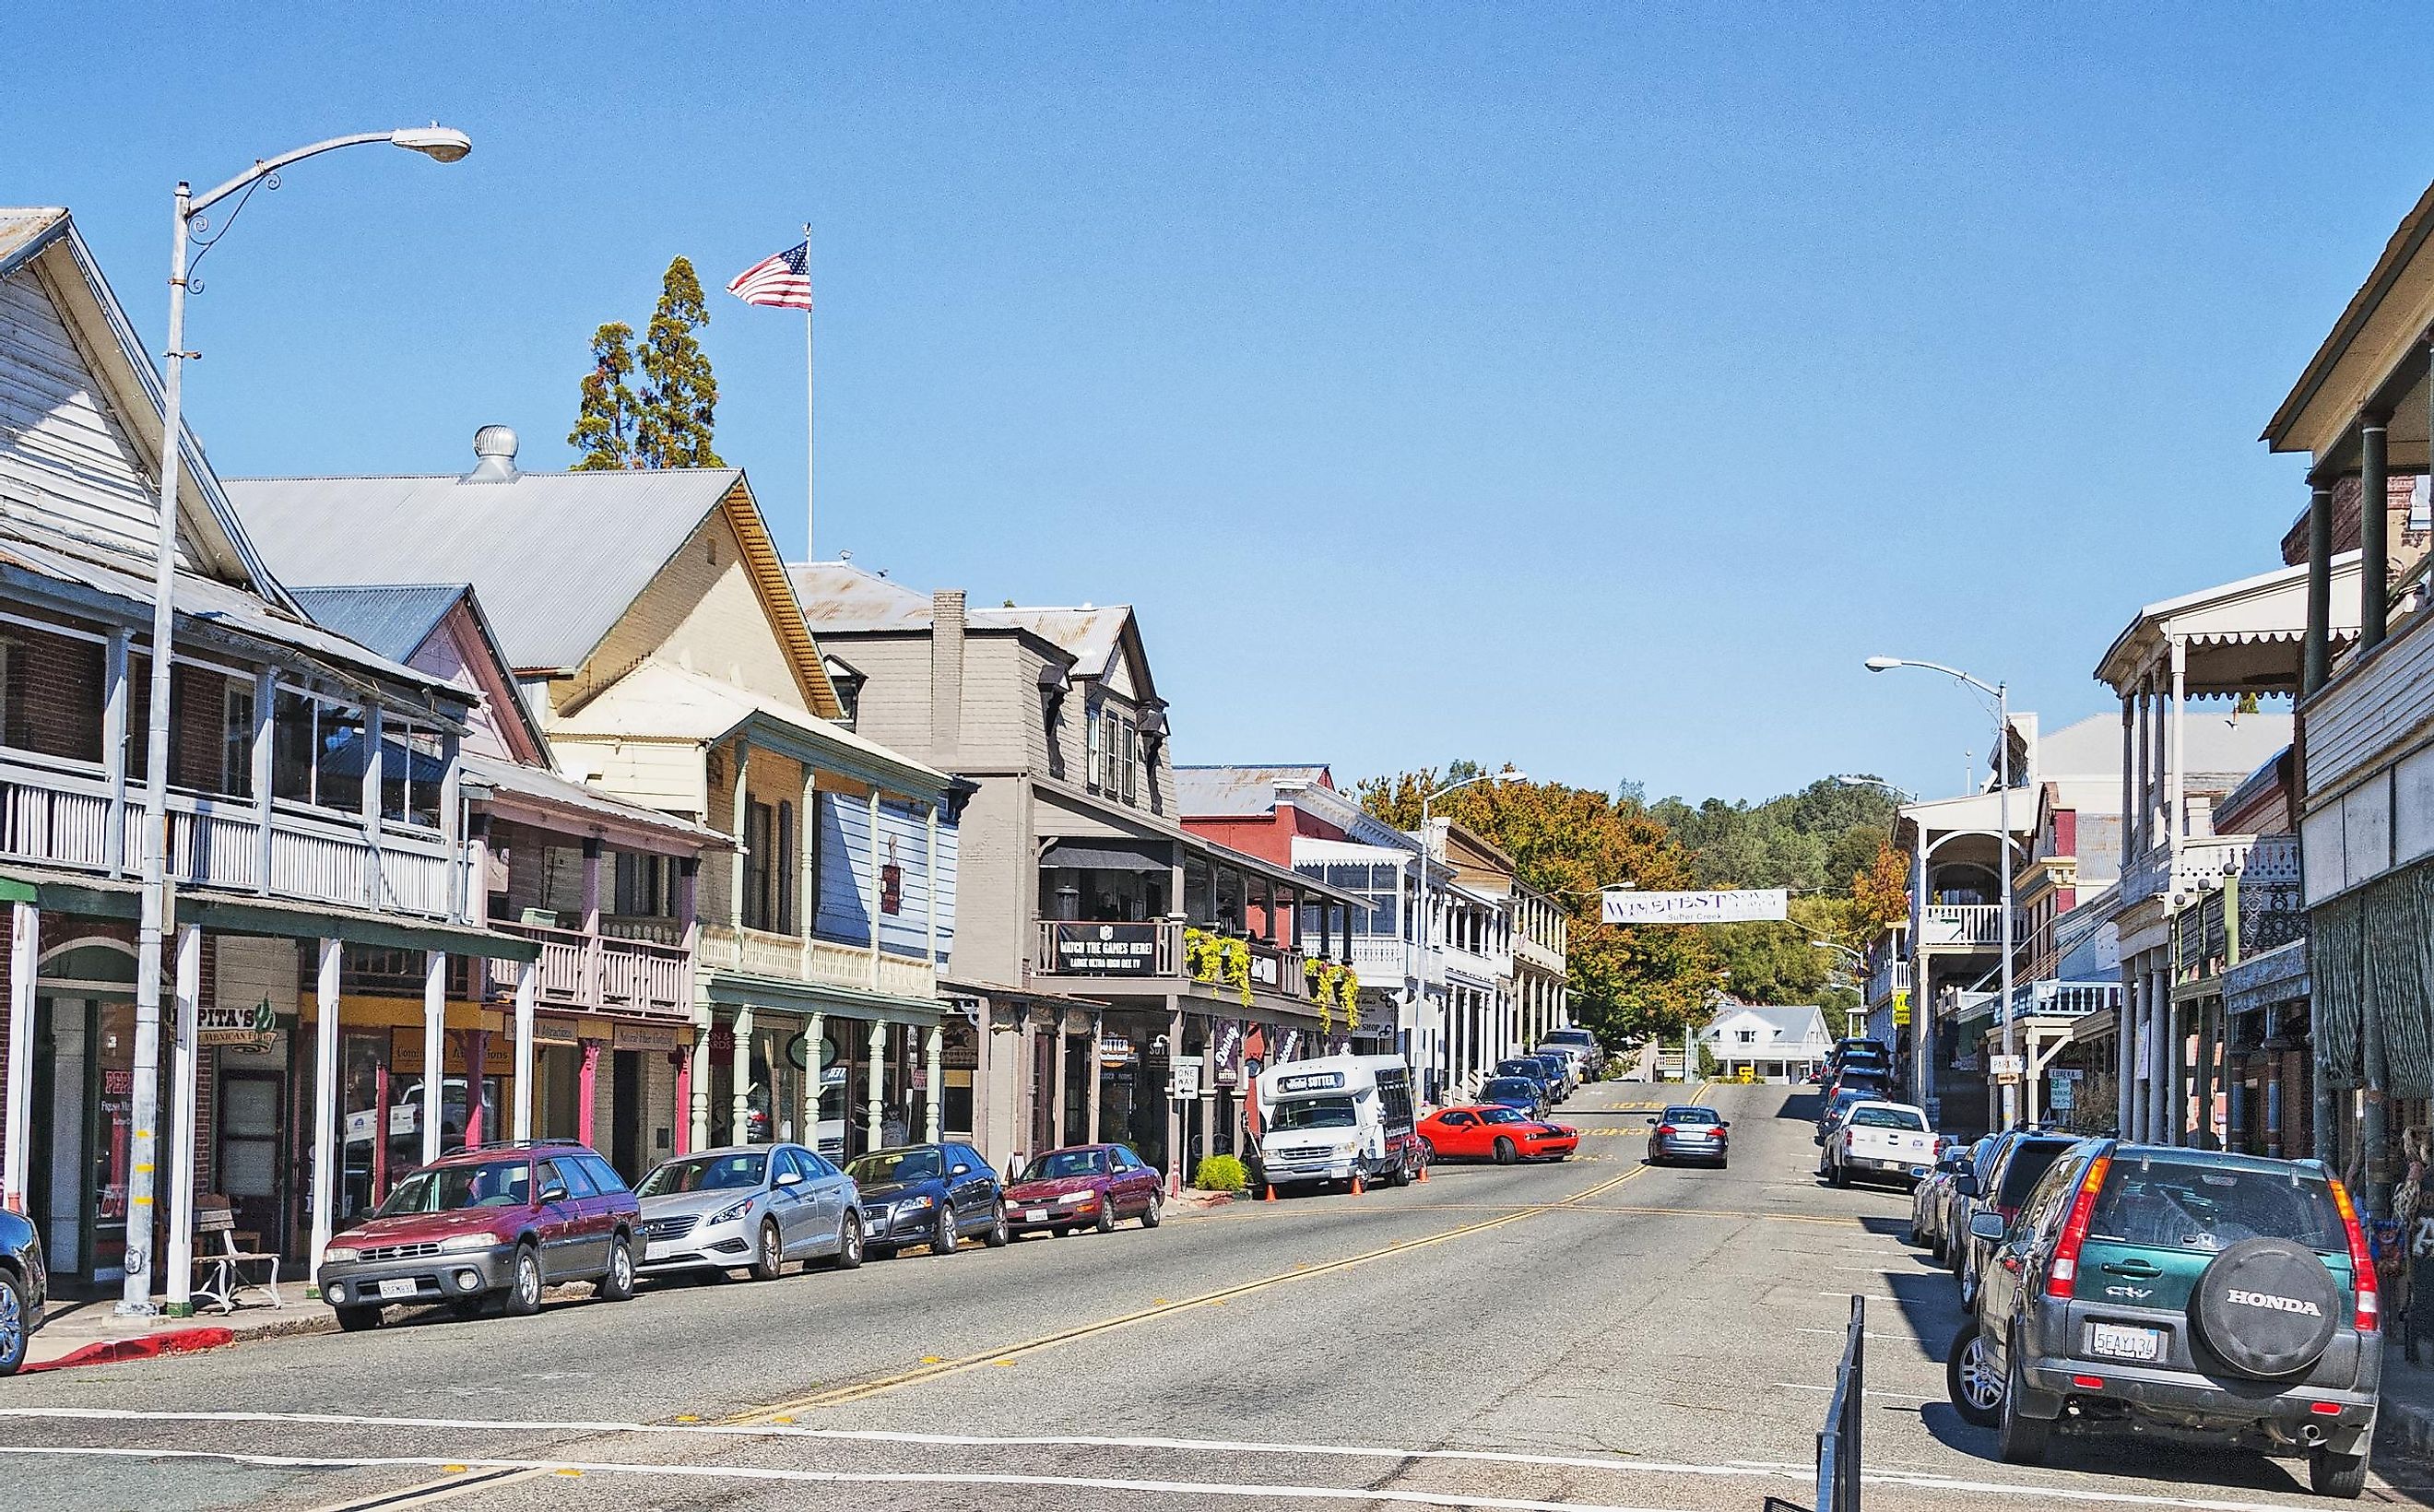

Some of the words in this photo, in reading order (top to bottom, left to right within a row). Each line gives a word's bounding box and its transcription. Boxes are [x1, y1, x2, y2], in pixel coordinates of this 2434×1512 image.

[1668, 913, 1694, 921] Sutter
[1696, 912, 1721, 920] Creek
[1060, 941, 1085, 953] WATCH
[1087, 941, 1102, 953] THE
[1103, 942, 1128, 954] GAMES
[1129, 942, 1152, 954] HERE!
[1070, 958, 1088, 967] LARGE
[1089, 959, 1105, 967] ULTRA
[1132, 959, 1140, 968] TV
[198, 1009, 255, 1027] PITA'S
[710, 1041, 731, 1050] ARDS
[1215, 1026, 1240, 1068] Dining
[1276, 1030, 1298, 1066] elcome
[397, 1047, 426, 1058] Comin
[1178, 1069, 1195, 1078] ONE
[1307, 1075, 1336, 1088] SUTTER
[2052, 1080, 2059, 1088] 2
[2227, 1289, 2322, 1317] HONDA
[2097, 1333, 2153, 1353] 5EAY134
